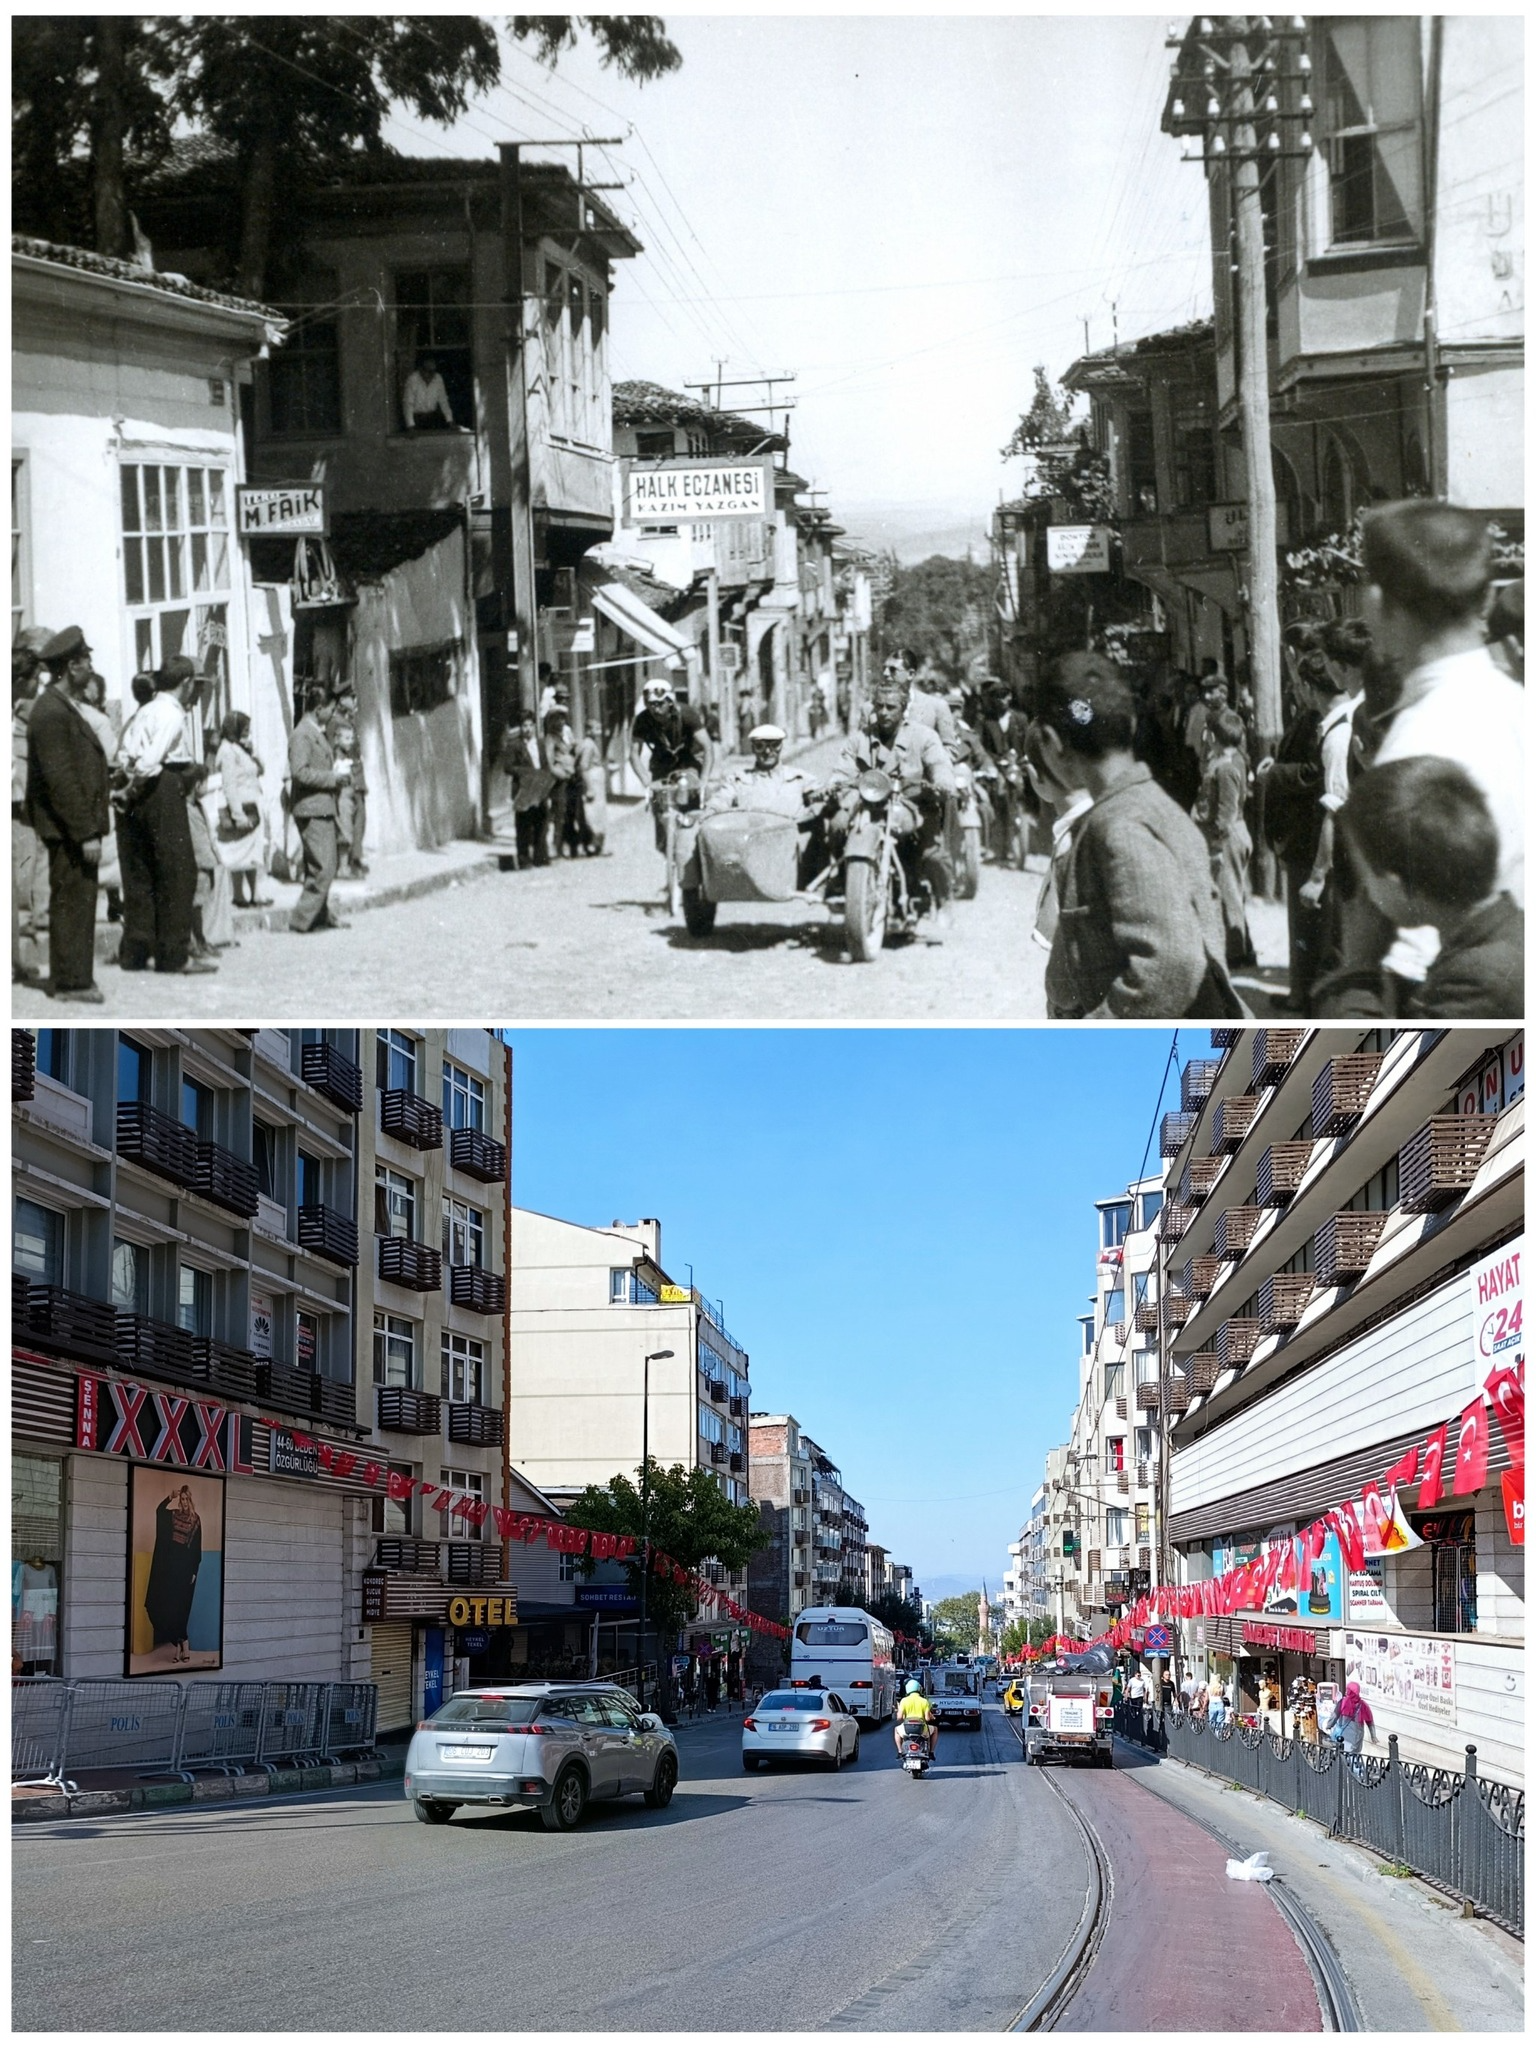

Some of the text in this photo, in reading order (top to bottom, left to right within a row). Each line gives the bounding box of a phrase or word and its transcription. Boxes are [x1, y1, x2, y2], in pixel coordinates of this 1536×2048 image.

[636, 472, 759, 499] HALK ECZANESİ
[638, 500, 759, 513] KAZIM YAZGAN
[1478, 1253, 1521, 1305] HAYAT
[1493, 1299, 1523, 1342] 24
[83, 1379, 93, 1448] ŞENNA
[104, 1383, 254, 1475] XXXL
[277, 1435, 294, 1451] 44-60
[276, 1451, 318, 1474] ÖZGÜRLÜĞÜ
[450, 1597, 518, 1627] OTEL
[425, 1670, 440, 1679] EYKEL
[425, 1681, 438, 1689] EKEL
[111, 1714, 140, 1731] POLİS
[214, 1711, 234, 1728] POLİS
